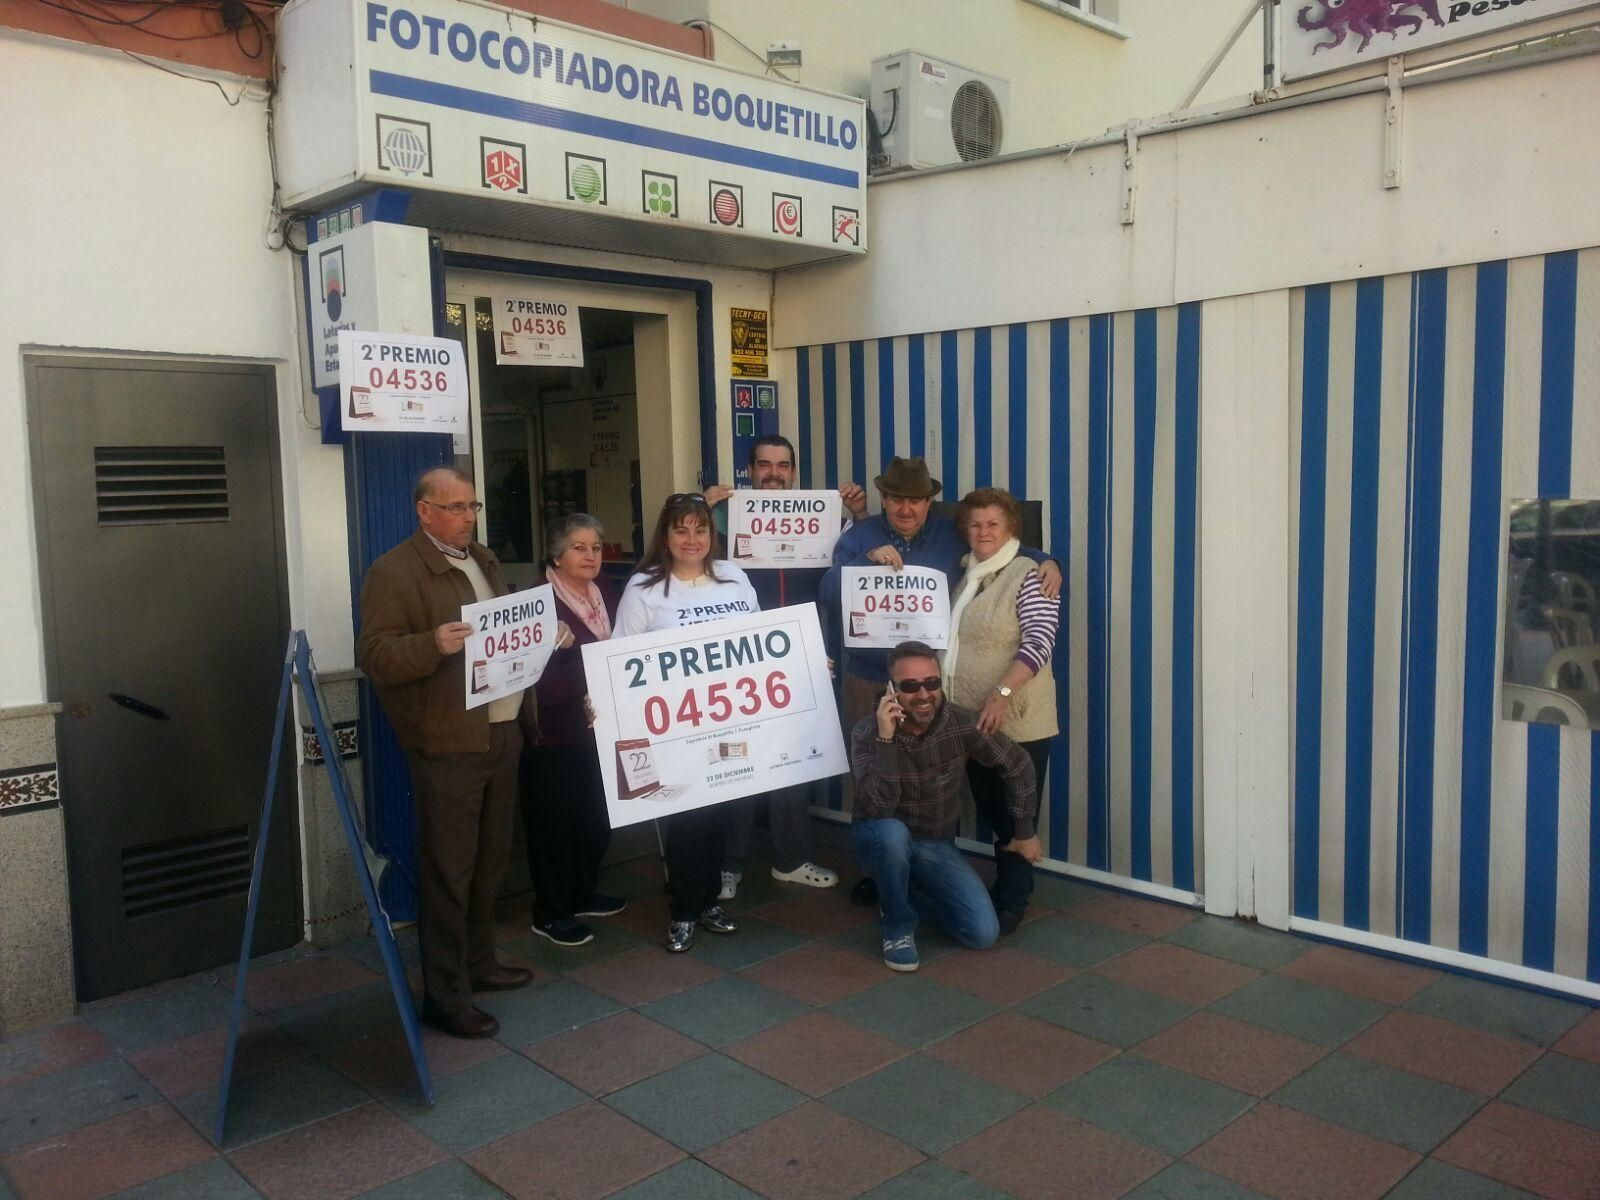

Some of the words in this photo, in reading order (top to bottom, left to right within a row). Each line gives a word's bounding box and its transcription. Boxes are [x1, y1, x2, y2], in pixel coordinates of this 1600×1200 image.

[366, 1, 683, 111] FOTOCOPIADORA
[692, 83, 858, 151] BOQUETILLO
[518, 302, 567, 316] PREMIO
[512, 317, 567, 336] 04536
[380, 344, 451, 366] PREMIO
[369, 367, 448, 392] 04536
[762, 499, 825, 513] PREMIO
[751, 517, 820, 535] 04536
[874, 575, 937, 591] PREMIO
[493, 599, 545, 628] PREMIO
[693, 600, 750, 617] PREMIO
[864, 594, 934, 613] 04536
[484, 622, 543, 658] 04536
[658, 629, 791, 682] PREMIO
[644, 670, 791, 736] 04536
[629, 751, 651, 772] 22
[723, 765, 755, 778] DICIEMBRE
